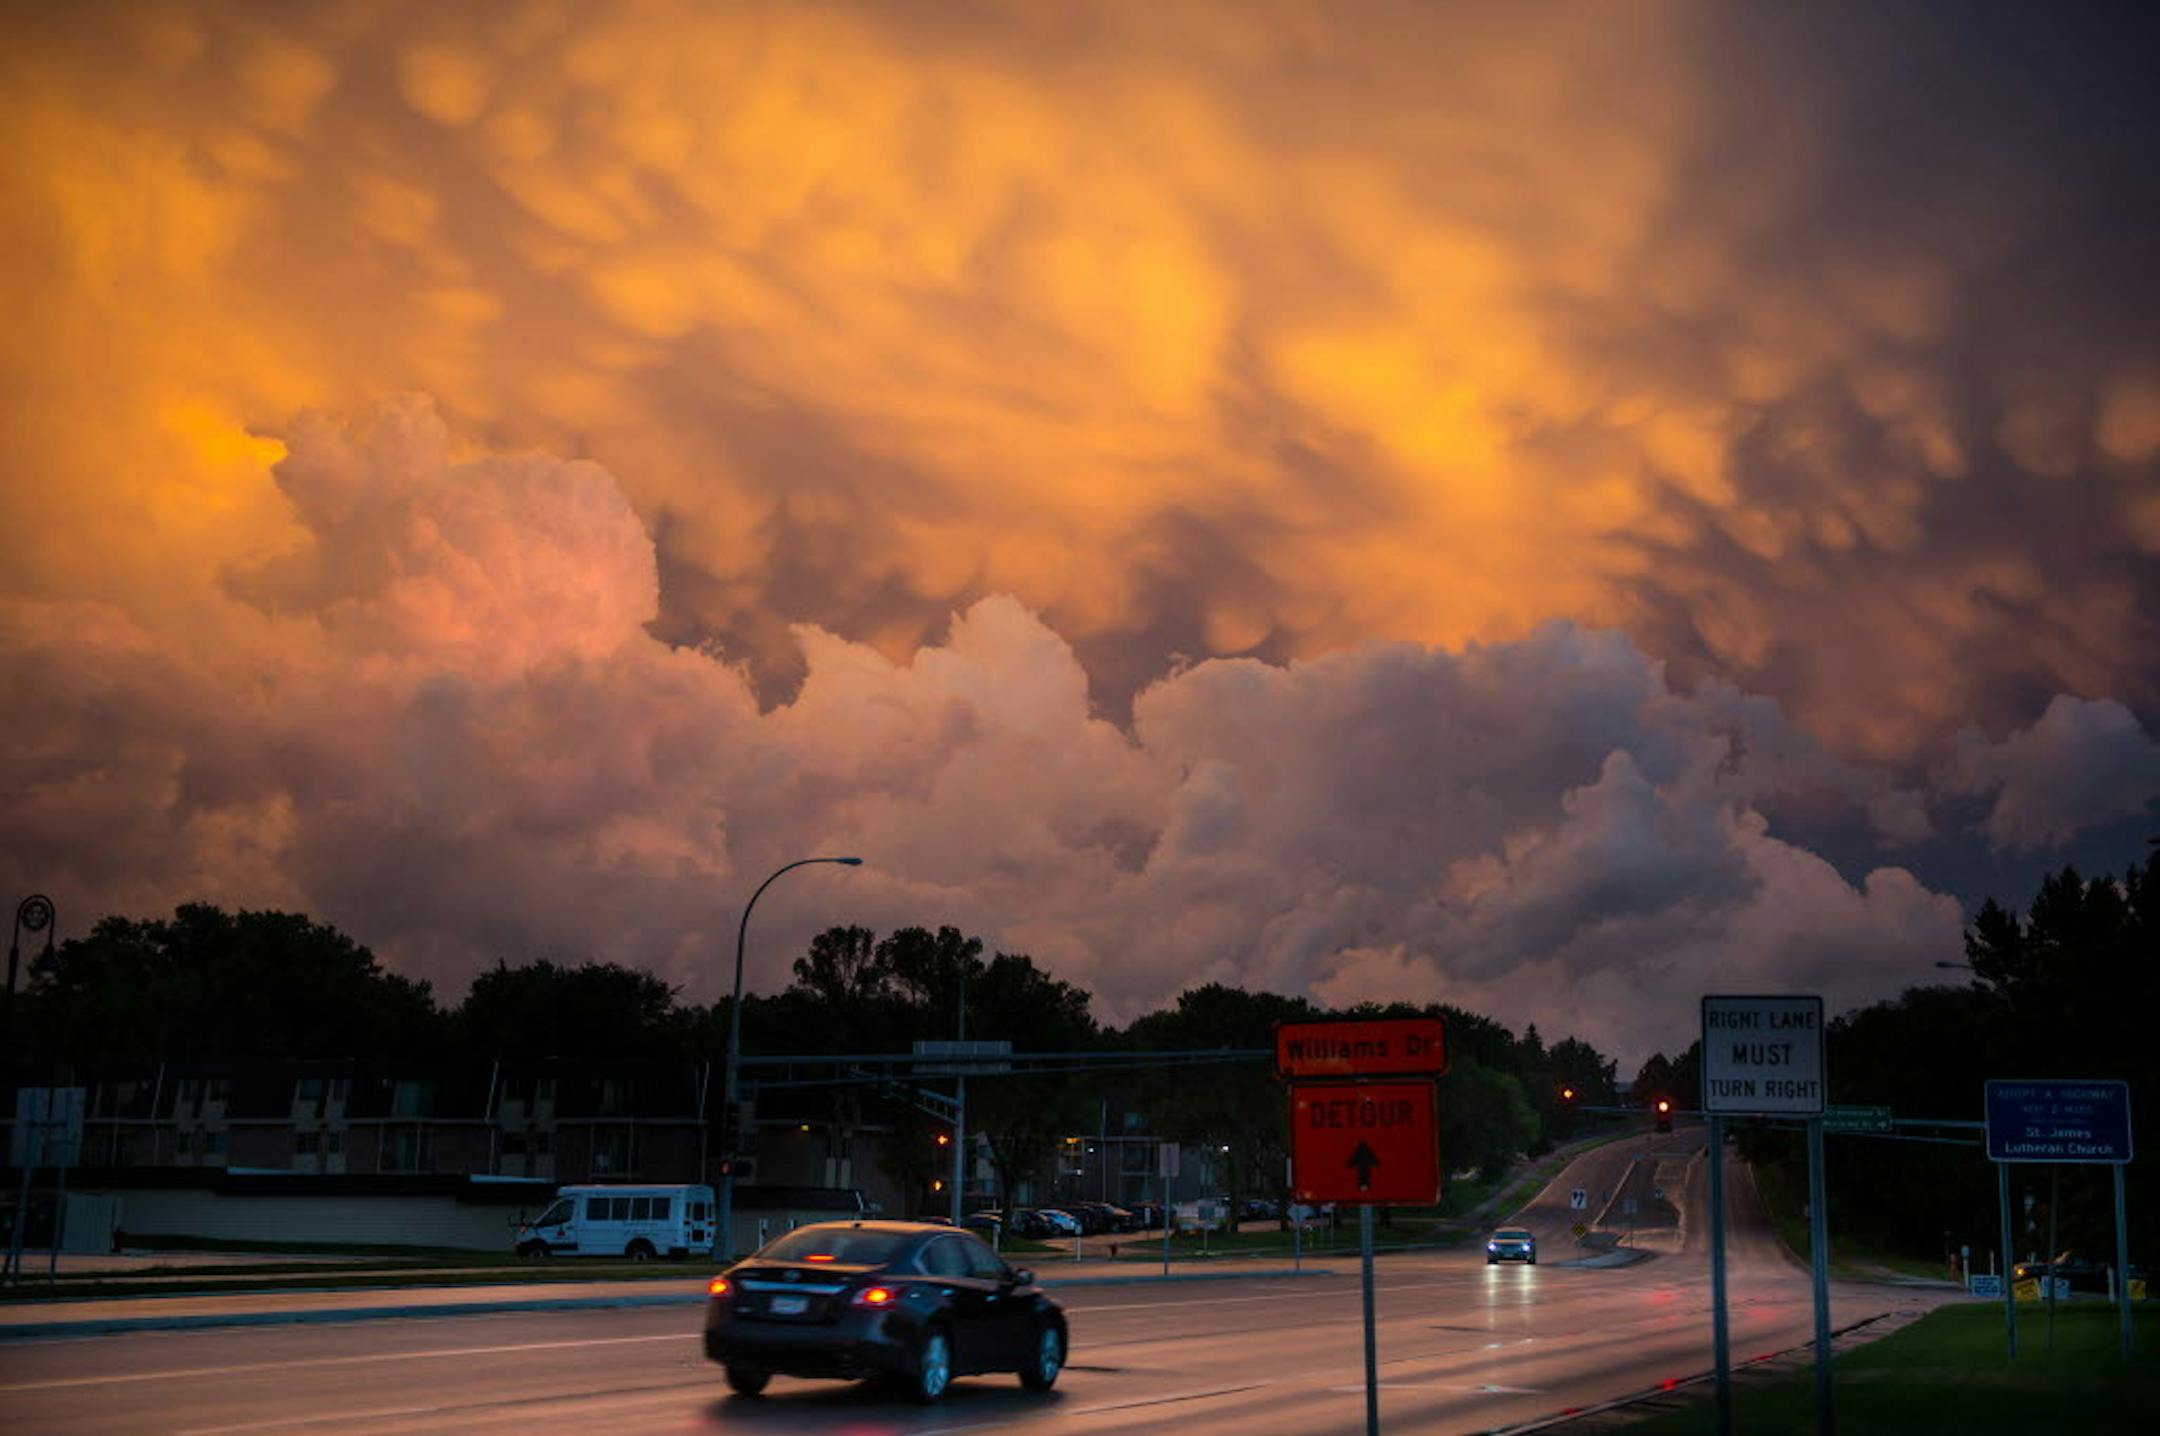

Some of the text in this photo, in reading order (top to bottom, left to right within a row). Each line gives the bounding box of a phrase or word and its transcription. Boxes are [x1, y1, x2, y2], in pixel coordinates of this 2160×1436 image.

[1708, 1011, 1816, 1029] RIGHT LANE
[1287, 1034, 1434, 1060] Williams Dr
[1732, 1044, 1792, 1065] MUST
[1709, 1079, 1818, 1099] TURN RIGHT
[1310, 1100, 1415, 1129] DETOUR
[2049, 1127, 2092, 1139] James
[2004, 1141, 2114, 1155] Lutheran Church
